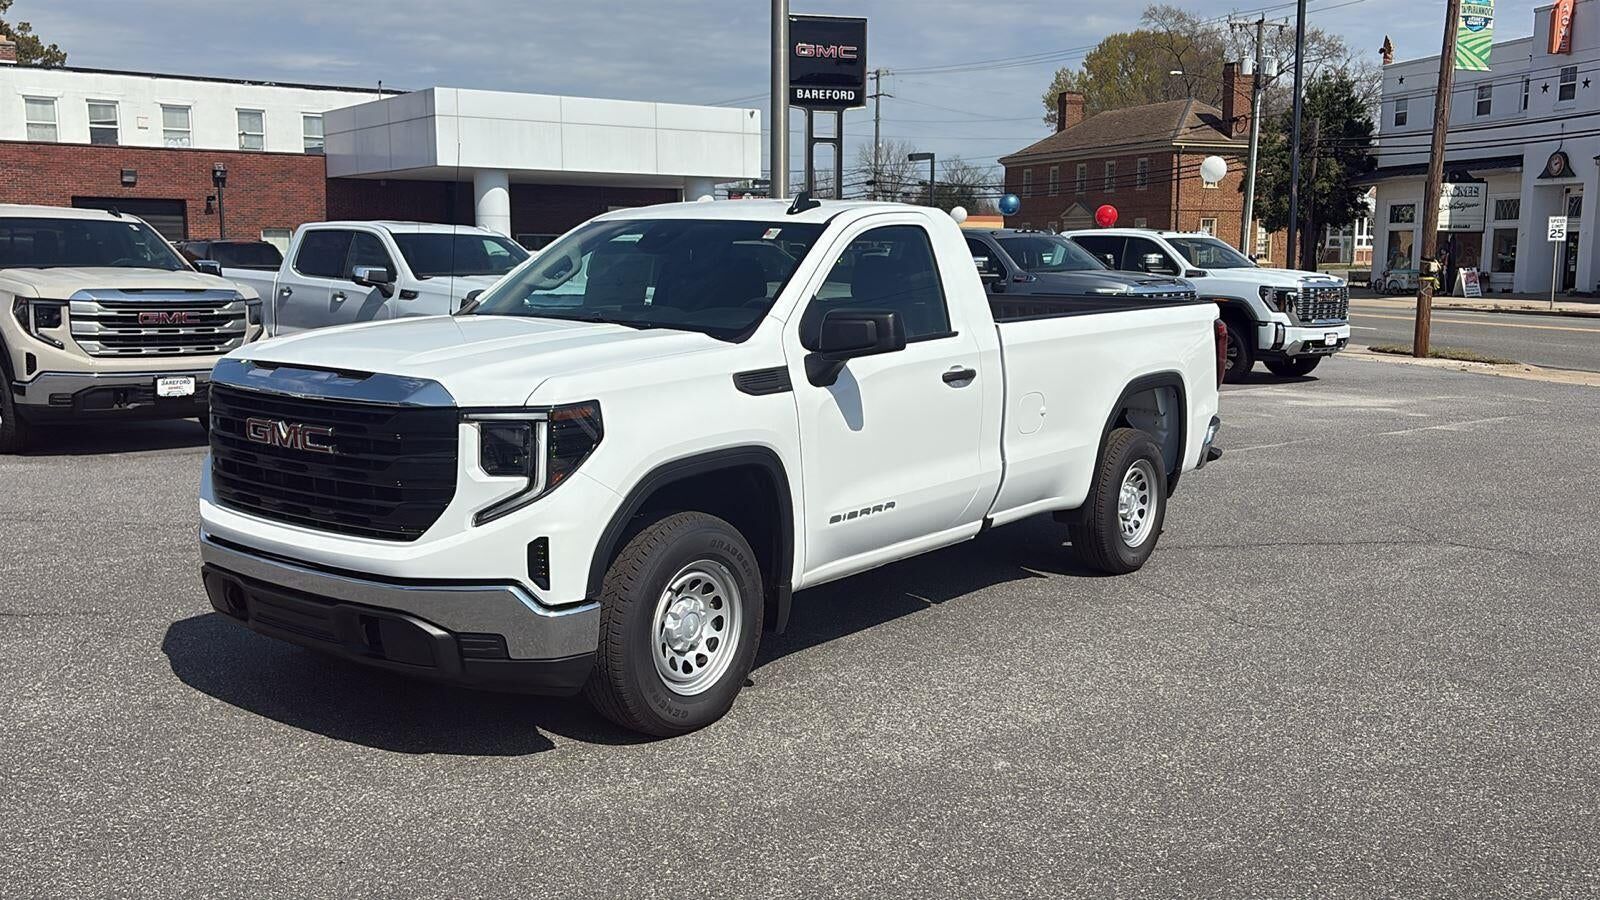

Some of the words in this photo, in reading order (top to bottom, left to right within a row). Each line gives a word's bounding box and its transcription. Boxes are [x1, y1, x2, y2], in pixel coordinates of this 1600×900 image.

[795, 42, 858, 59] GMC
[796, 88, 855, 101] BAREFORD
[1549, 228, 1565, 239] 25
[138, 311, 201, 325] GMC
[245, 417, 335, 455] GMC
[829, 501, 896, 525] SIERRA
